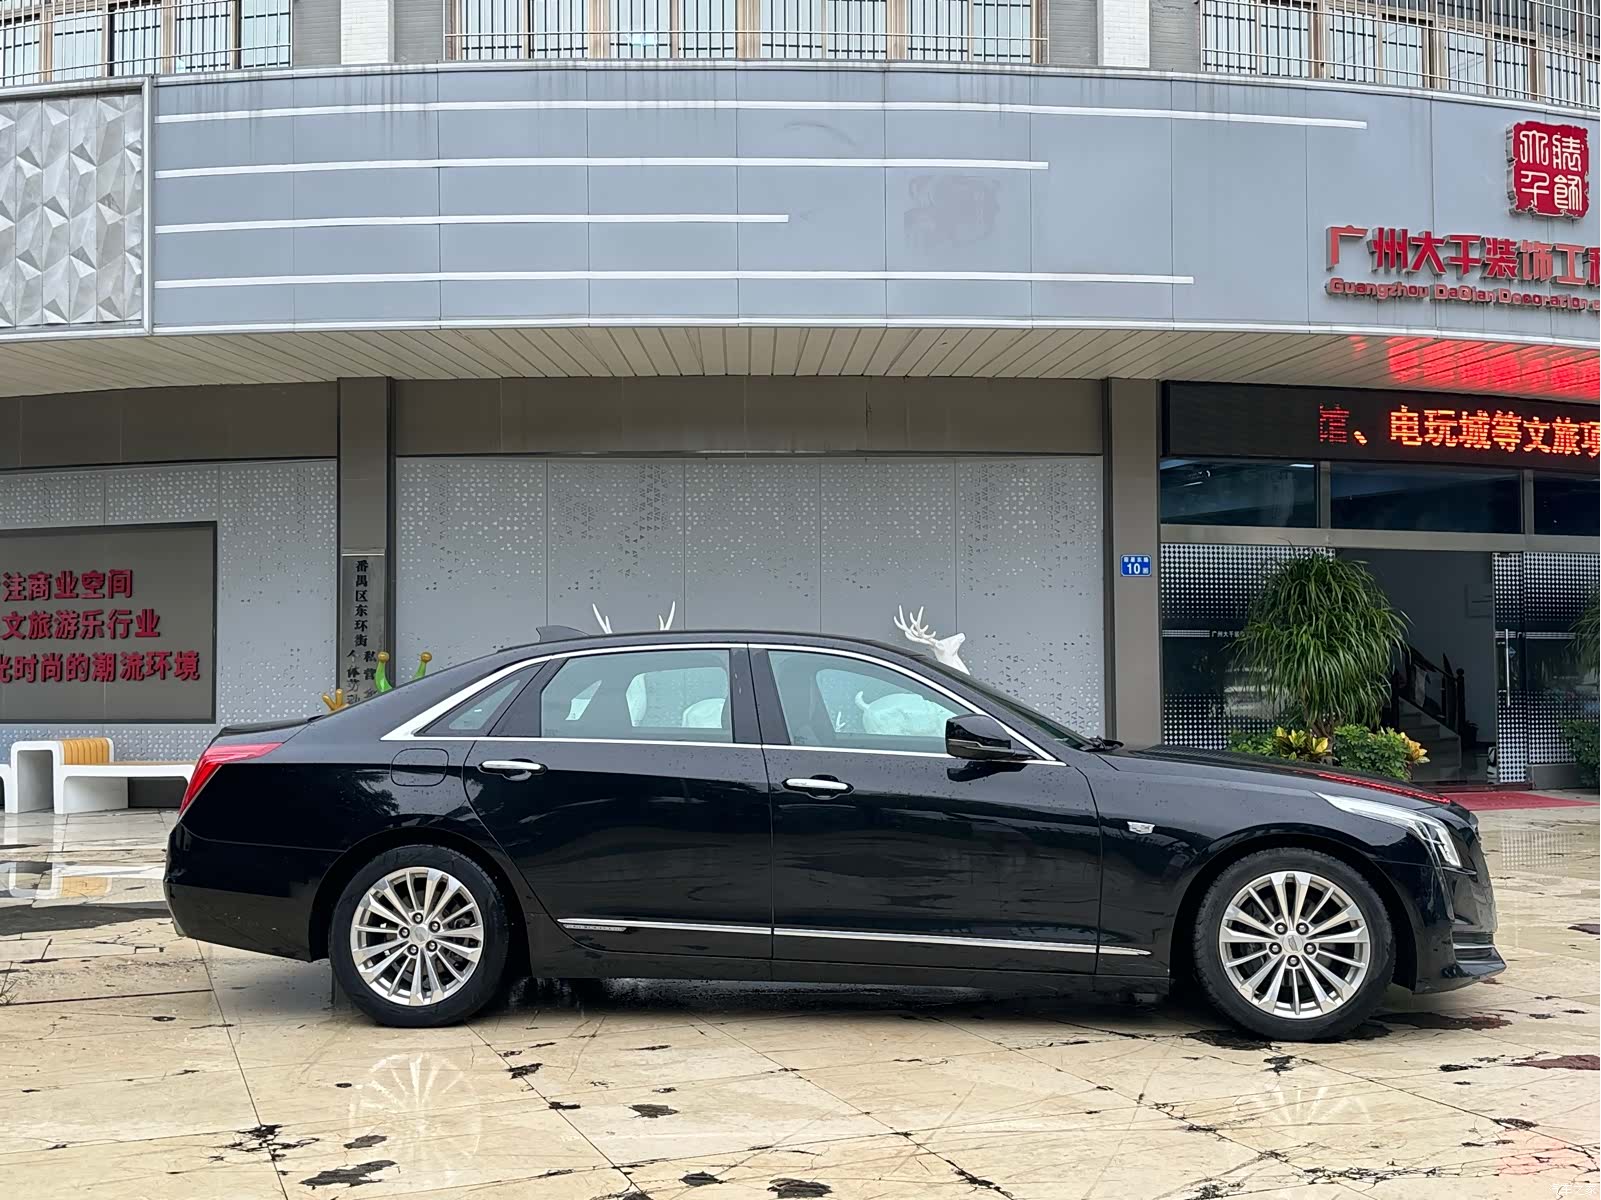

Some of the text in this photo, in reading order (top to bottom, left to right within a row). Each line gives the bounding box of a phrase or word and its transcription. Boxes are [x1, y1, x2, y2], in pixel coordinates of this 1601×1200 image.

[1328, 277, 1429, 300] Guangzhou
[1498, 288, 1588, 312] Decoration
[2, 569, 133, 602] 注商业空间
[1, 609, 161, 640] 文旅游乐行业
